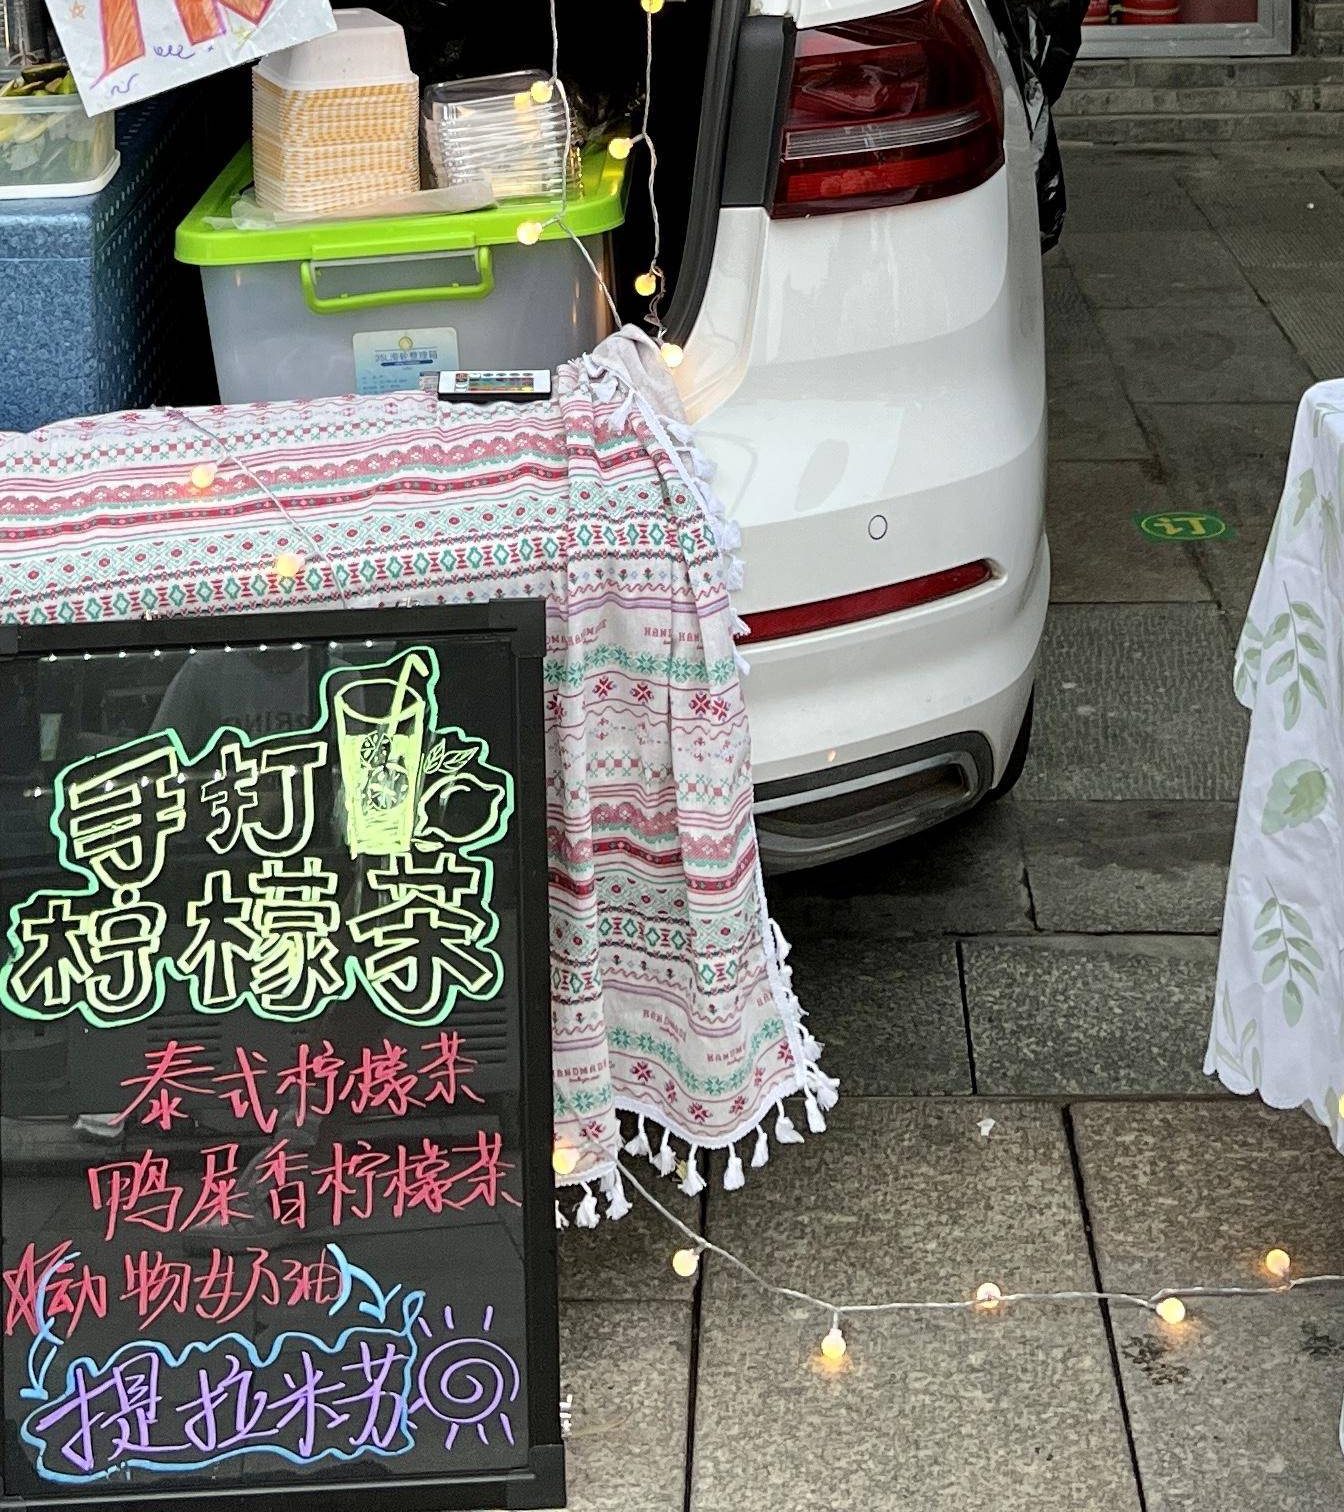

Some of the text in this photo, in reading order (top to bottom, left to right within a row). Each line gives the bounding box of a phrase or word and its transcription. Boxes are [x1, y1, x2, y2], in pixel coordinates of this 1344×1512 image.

[11, 850, 494, 1014] 柠檬茶
[107, 1031, 486, 1134] 泰式柠檬茶
[87, 1129, 524, 1242] 鸭屎香柠檬茶
[37, 1341, 407, 1472] 提拉米苏
